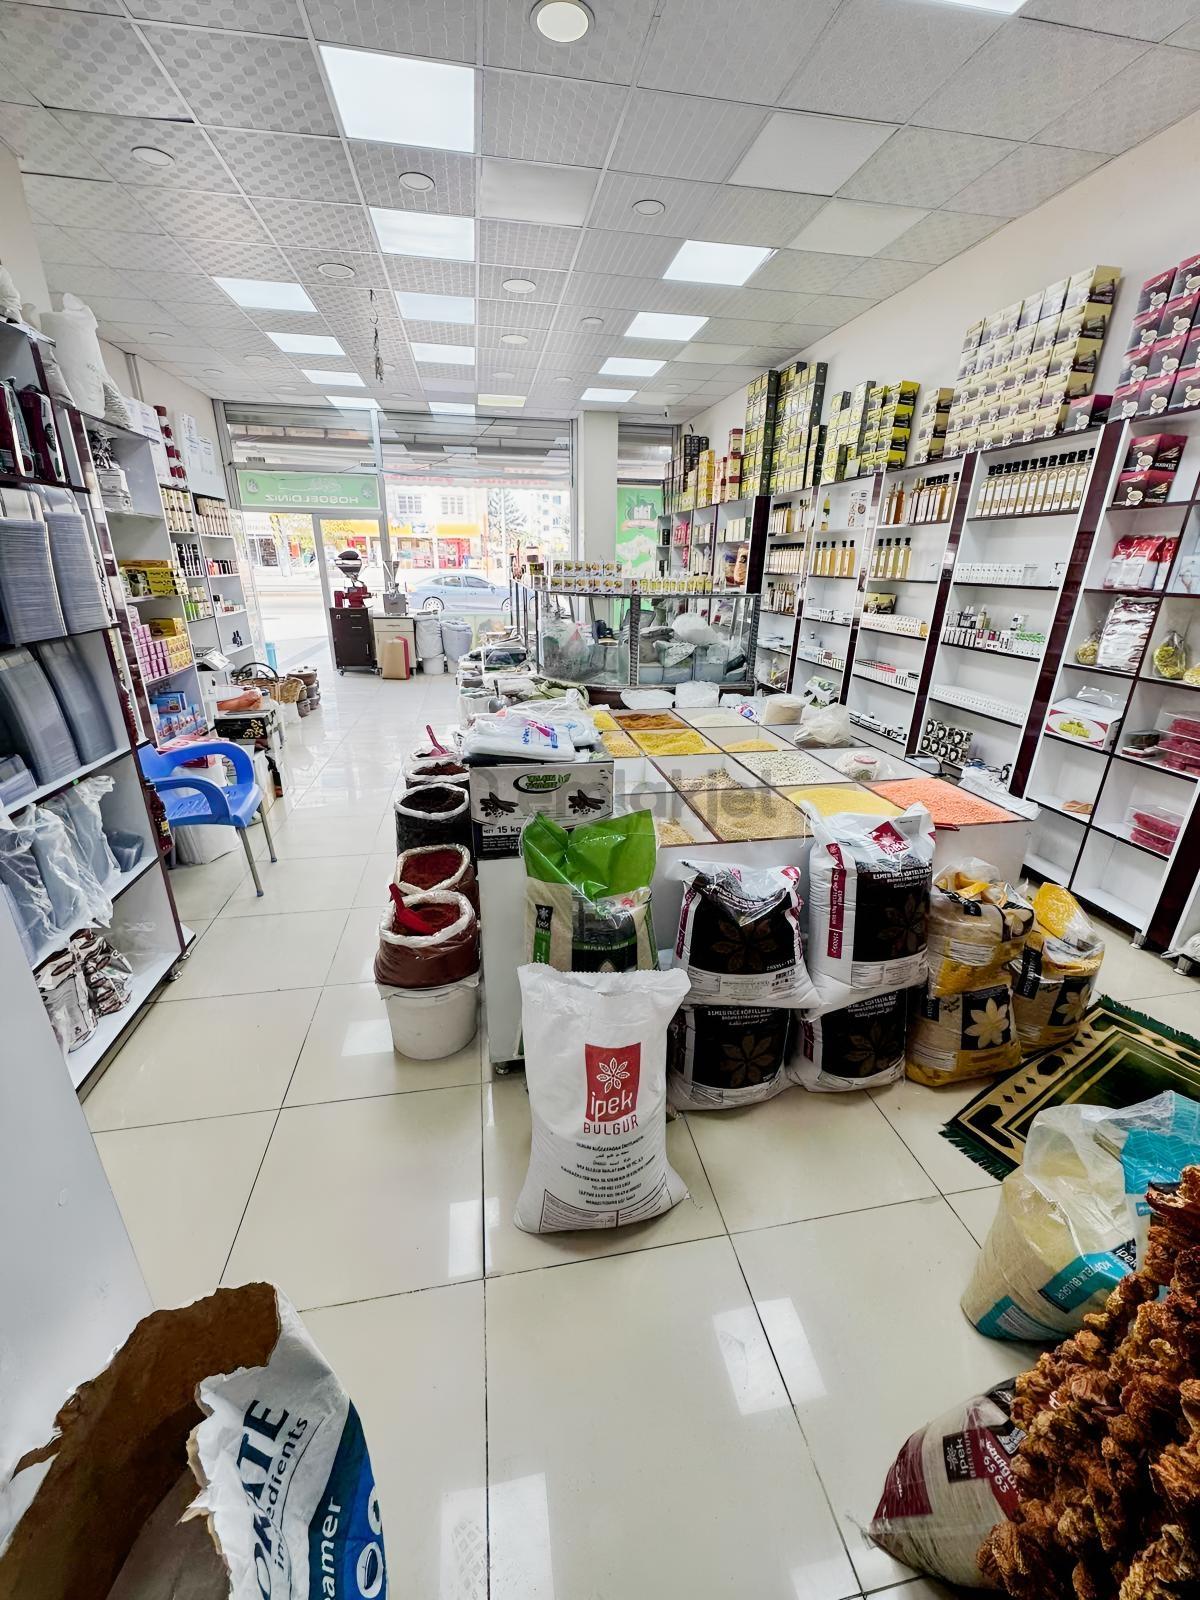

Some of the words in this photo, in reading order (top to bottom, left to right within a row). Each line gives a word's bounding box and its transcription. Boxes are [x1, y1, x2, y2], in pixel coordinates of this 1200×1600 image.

[497, 826, 508, 834] 15
[590, 1089, 633, 1122] ipek
[583, 1114, 639, 1136] BULGUR
[983, 1455, 998, 1474] 65
[994, 1474, 1010, 1493] 63
[320, 1496, 342, 1600] amer
